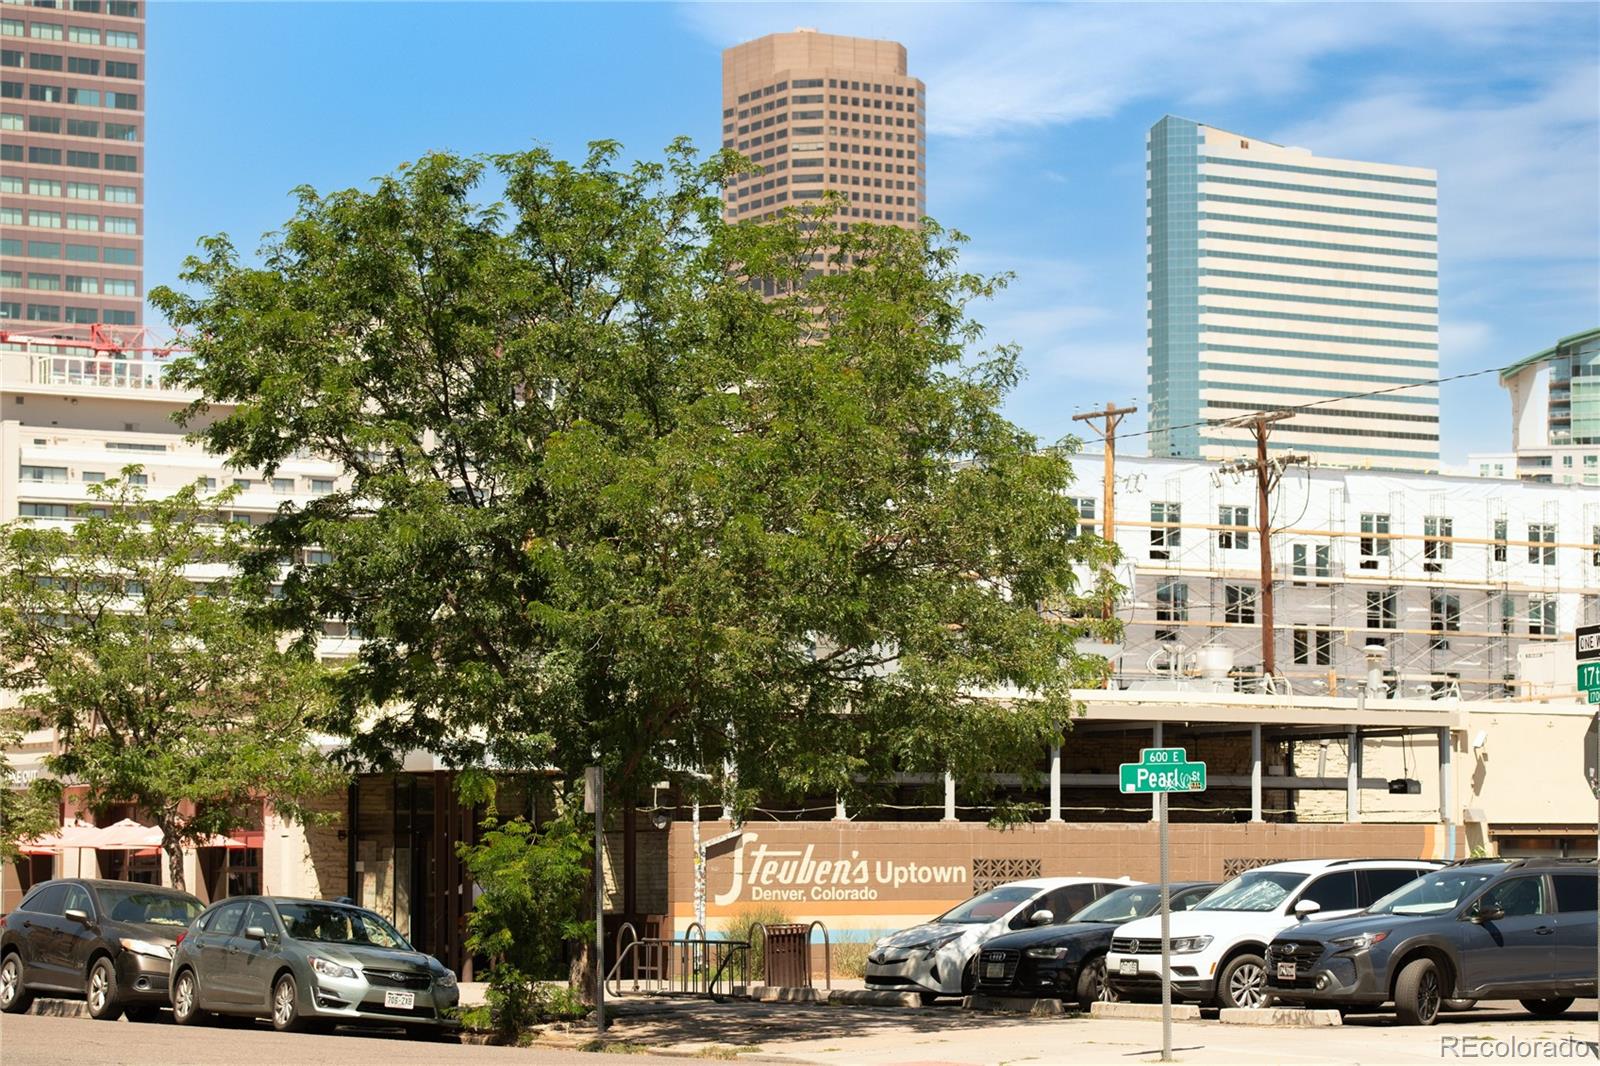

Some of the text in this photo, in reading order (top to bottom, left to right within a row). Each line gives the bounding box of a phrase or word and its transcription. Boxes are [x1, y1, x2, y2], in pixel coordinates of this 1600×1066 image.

[1580, 635, 1594, 650] ONE
[1149, 751, 1179, 763] 600 E
[1137, 768, 1179, 788] Pearl
[1191, 771, 1201, 781] St
[714, 832, 967, 906] Steuben's Uptown
[751, 886, 878, 903] Denver, Colorado
